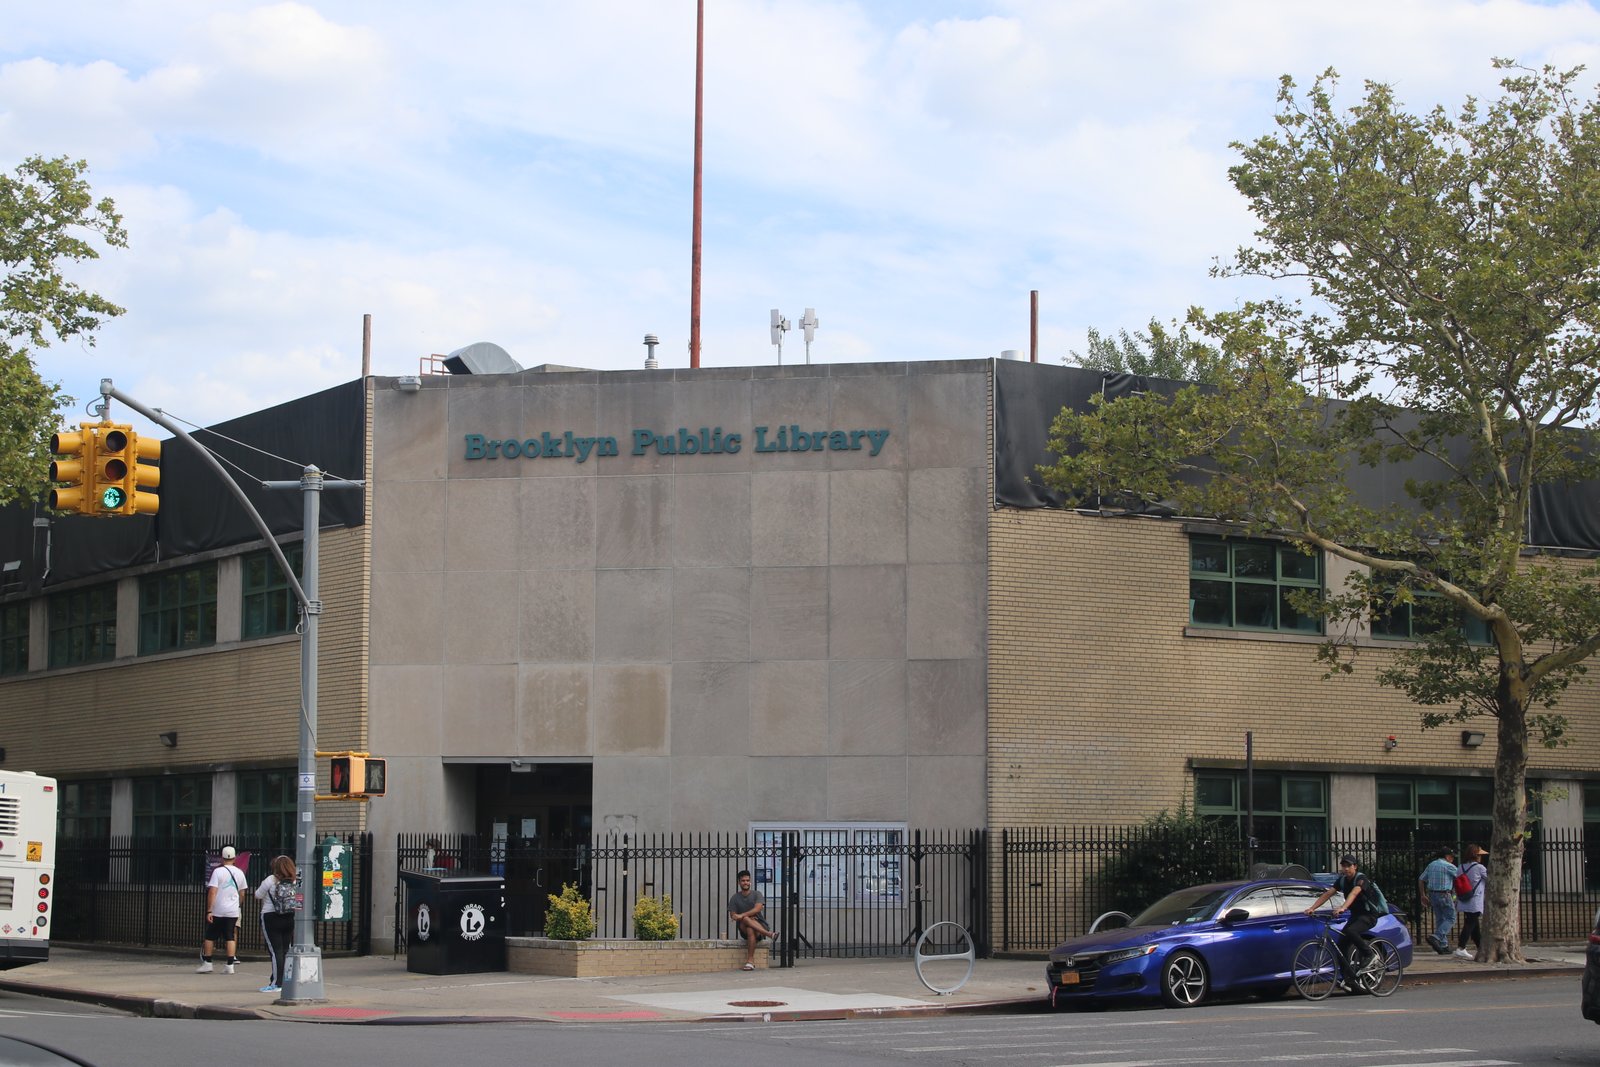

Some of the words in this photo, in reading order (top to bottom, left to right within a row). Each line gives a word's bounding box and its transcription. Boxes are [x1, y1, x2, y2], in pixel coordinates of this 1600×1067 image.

[464, 432, 619, 463] Brooklyn
[632, 427, 742, 455] Public
[755, 424, 890, 456] Library
[461, 903, 485, 914] LIBRARY
[461, 931, 485, 941] RETURN
